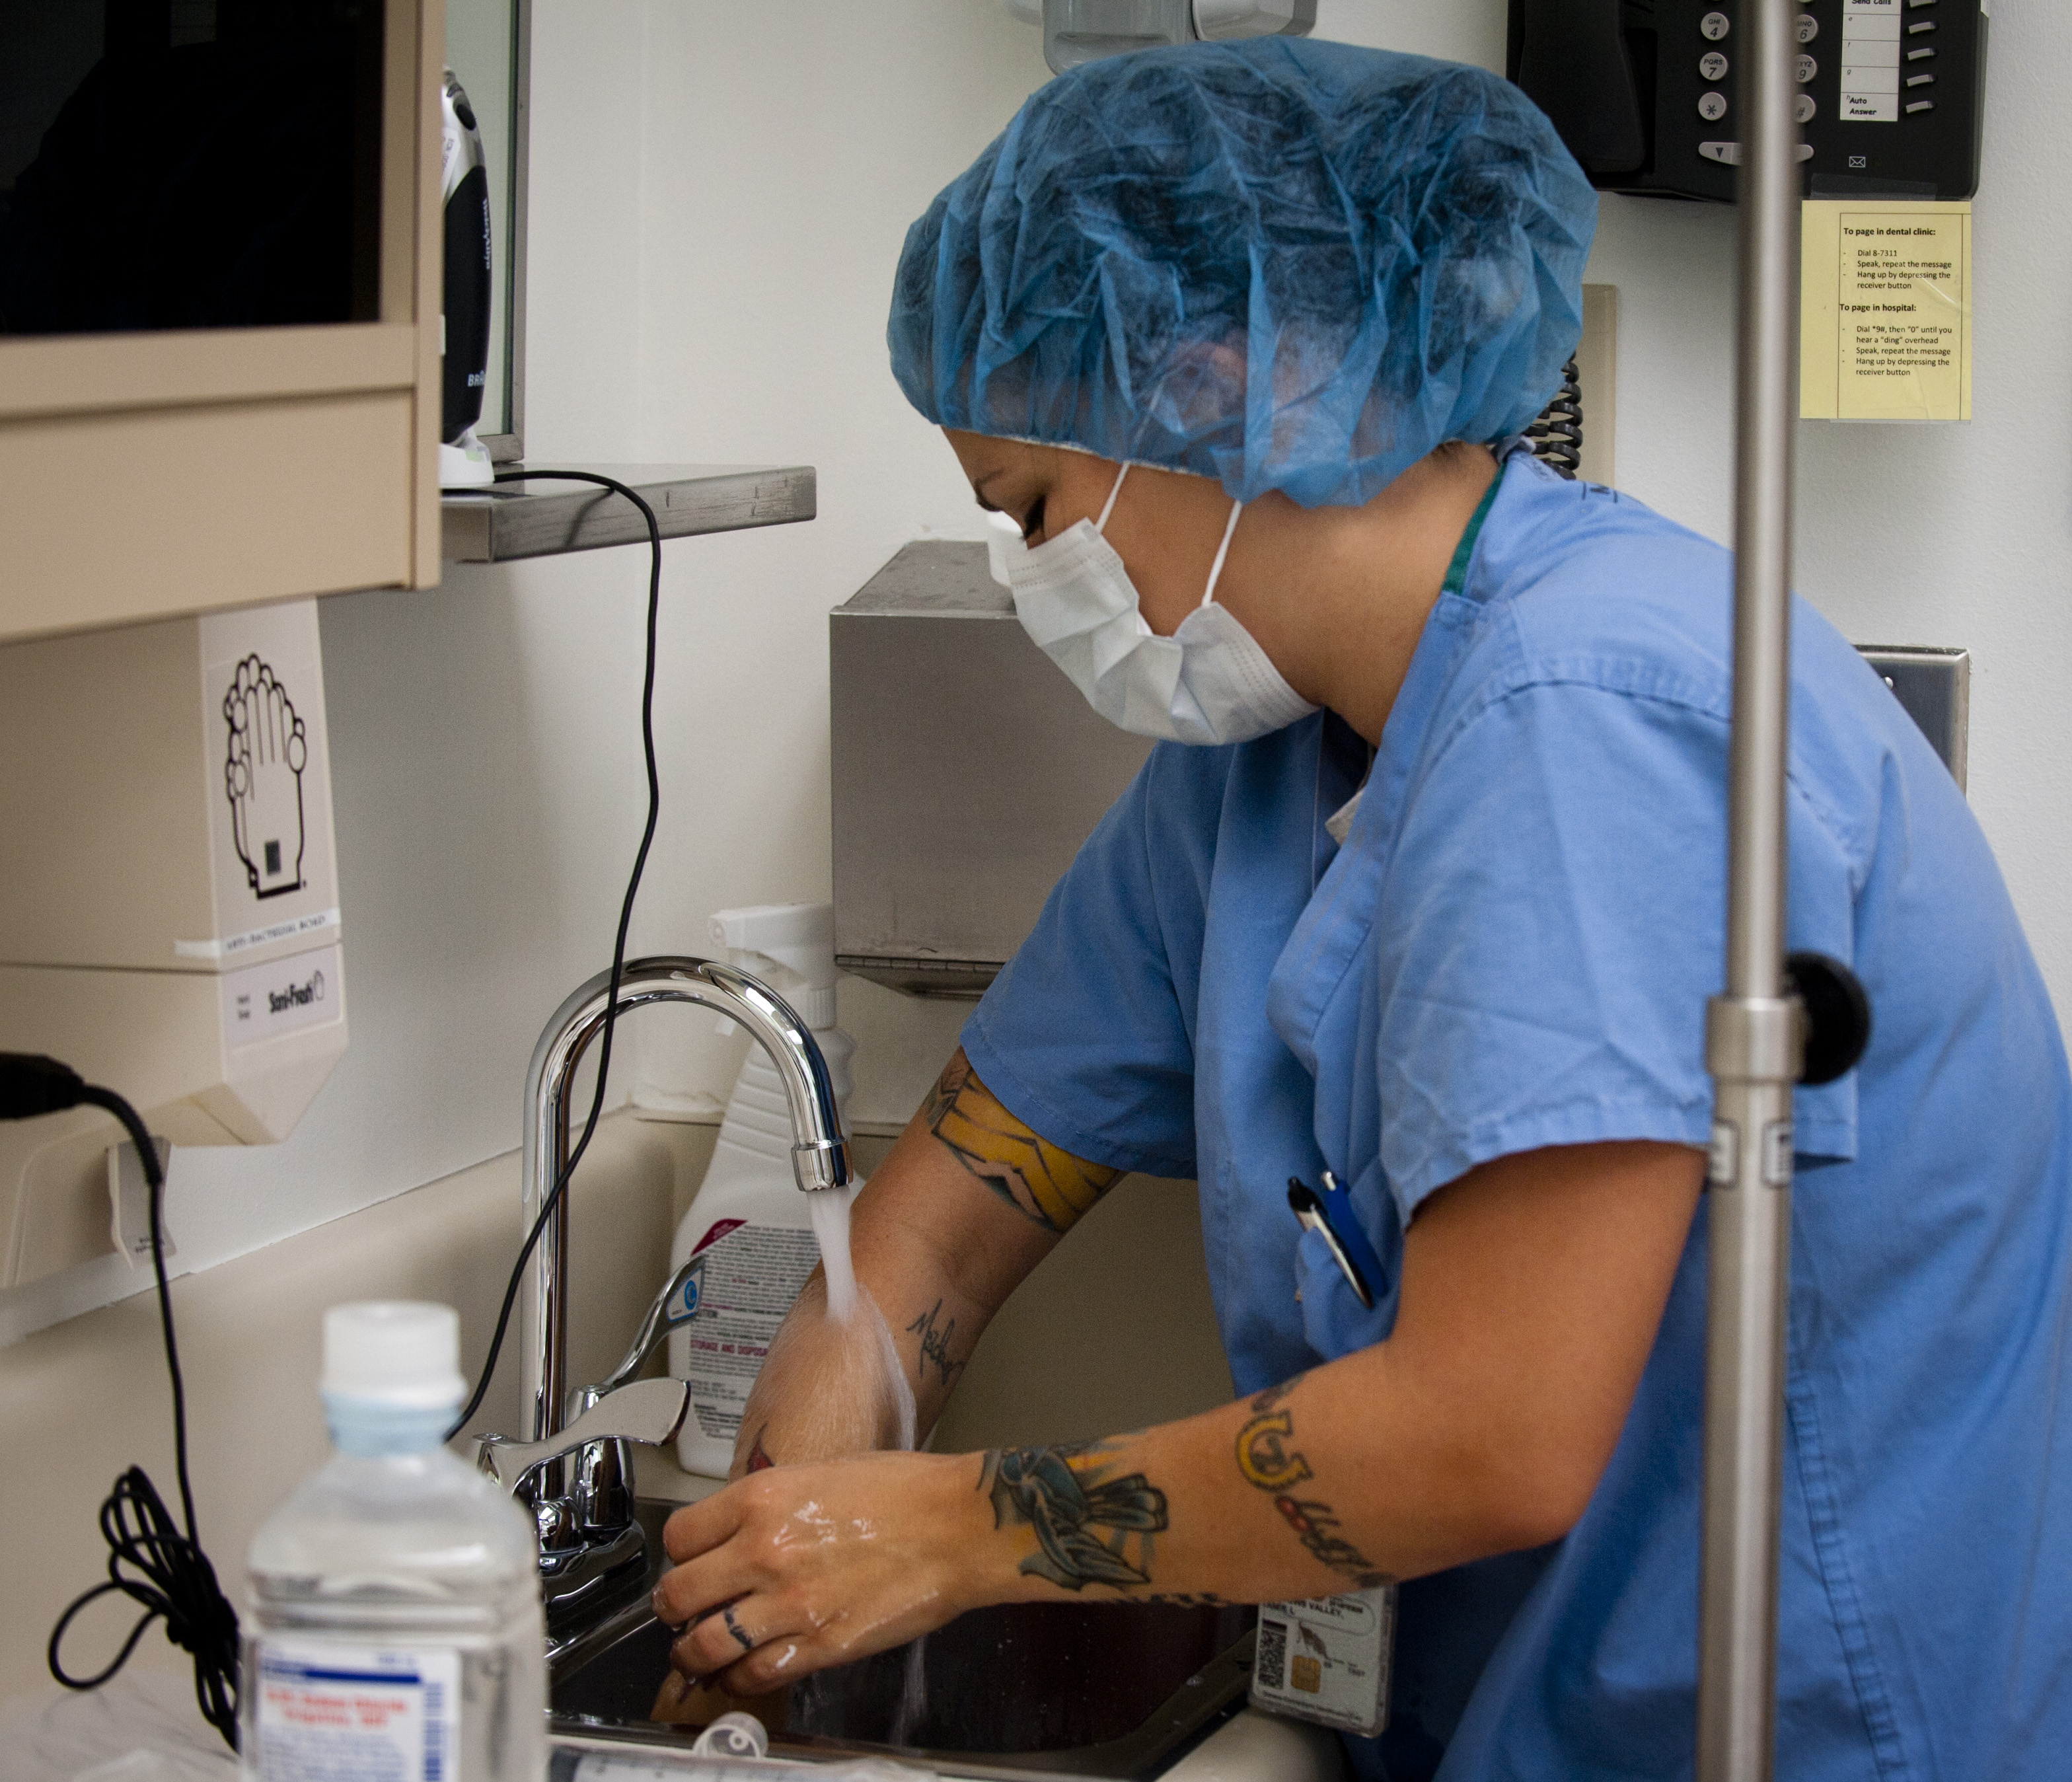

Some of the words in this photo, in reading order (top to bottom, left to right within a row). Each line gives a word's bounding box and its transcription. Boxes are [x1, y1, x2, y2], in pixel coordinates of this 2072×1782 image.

[1710, 27, 1718, 38] 4
[1800, 29, 1808, 40] 6
[1709, 67, 1717, 78] 7
[1798, 69, 1807, 80] 9
[1857, 271, 1876, 279] Hang
[1888, 271, 1897, 279] by
[1899, 271, 1937, 280] depressing
[1882, 304, 1916, 313] hospital:
[1888, 357, 1896, 366] by
[1898, 358, 1936, 367] depressing
